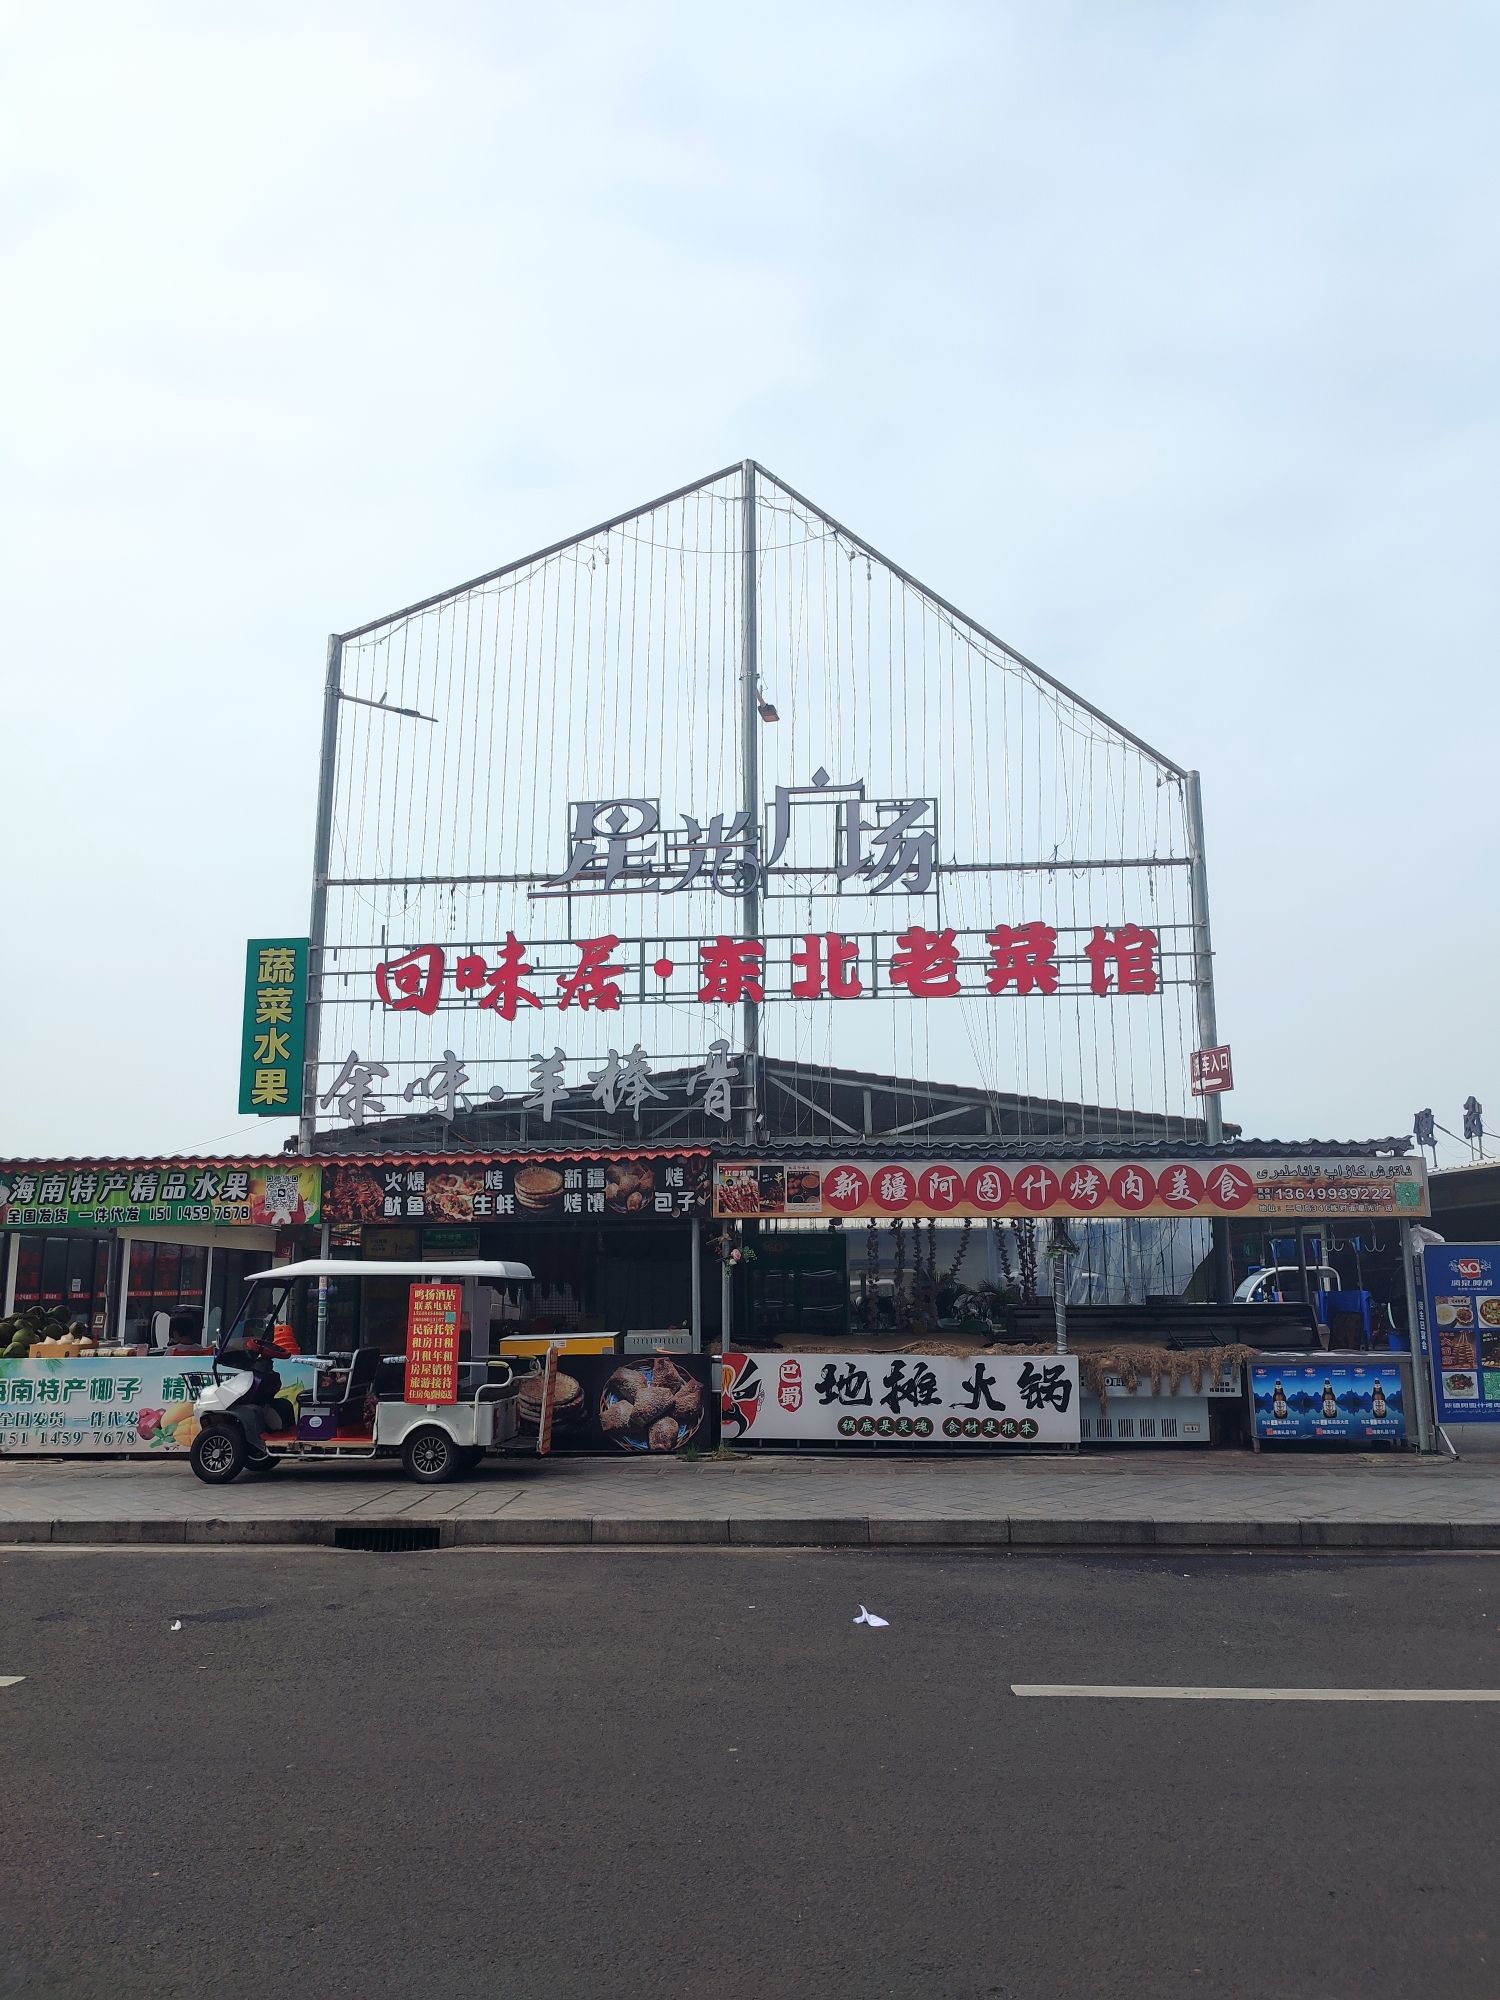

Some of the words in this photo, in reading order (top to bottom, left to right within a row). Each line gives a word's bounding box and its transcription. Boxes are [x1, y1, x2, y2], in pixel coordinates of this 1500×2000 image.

[528, 766, 936, 898] 星光广场
[251, 948, 296, 1105] 蔬菜水果
[384, 1171, 425, 1192] 火爆
[485, 1170, 503, 1190] 烤
[564, 1168, 605, 1189] 新疆
[665, 1167, 684, 1187] 烤
[829, 1167, 1249, 1205] 新疆阿图什烤肉美食
[9, 1172, 250, 1203] 海南特产精品水果
[1276, 1187, 1392, 1200] 13649939222
[384, 1195, 425, 1216] 鱿鱼
[473, 1195, 514, 1216] 生蚝
[564, 1193, 605, 1213] 烤馕
[655, 1192, 695, 1212] 包子
[7, 1207, 68, 1223] 全国发货
[78, 1206, 140, 1222] 一件代发
[150, 1206, 171, 1221] 151
[177, 1205, 210, 1220] 1459
[215, 1205, 250, 1220] 7678
[413, 1324, 455, 1335] 民宿托管
[412, 1338, 453, 1348] 租房日租
[412, 1351, 453, 1361] 月租年租
[411, 1364, 452, 1375] 房屋销售
[410, 1377, 451, 1388] 旅游接待
[780, 1363, 802, 1408] 巴蜀
[814, 1359, 1073, 1414] 地摊火锅
[0, 1411, 64, 1427] 全国发货
[73, 1411, 139, 1427] 一件代发
[841, 1418, 930, 1434] 锅底是灵魂
[946, 1419, 1036, 1435] 食材是根本
[0, 1431, 28, 1445] 151
[41, 1431, 81, 1445] 1459
[93, 1431, 136, 1444] 7678
